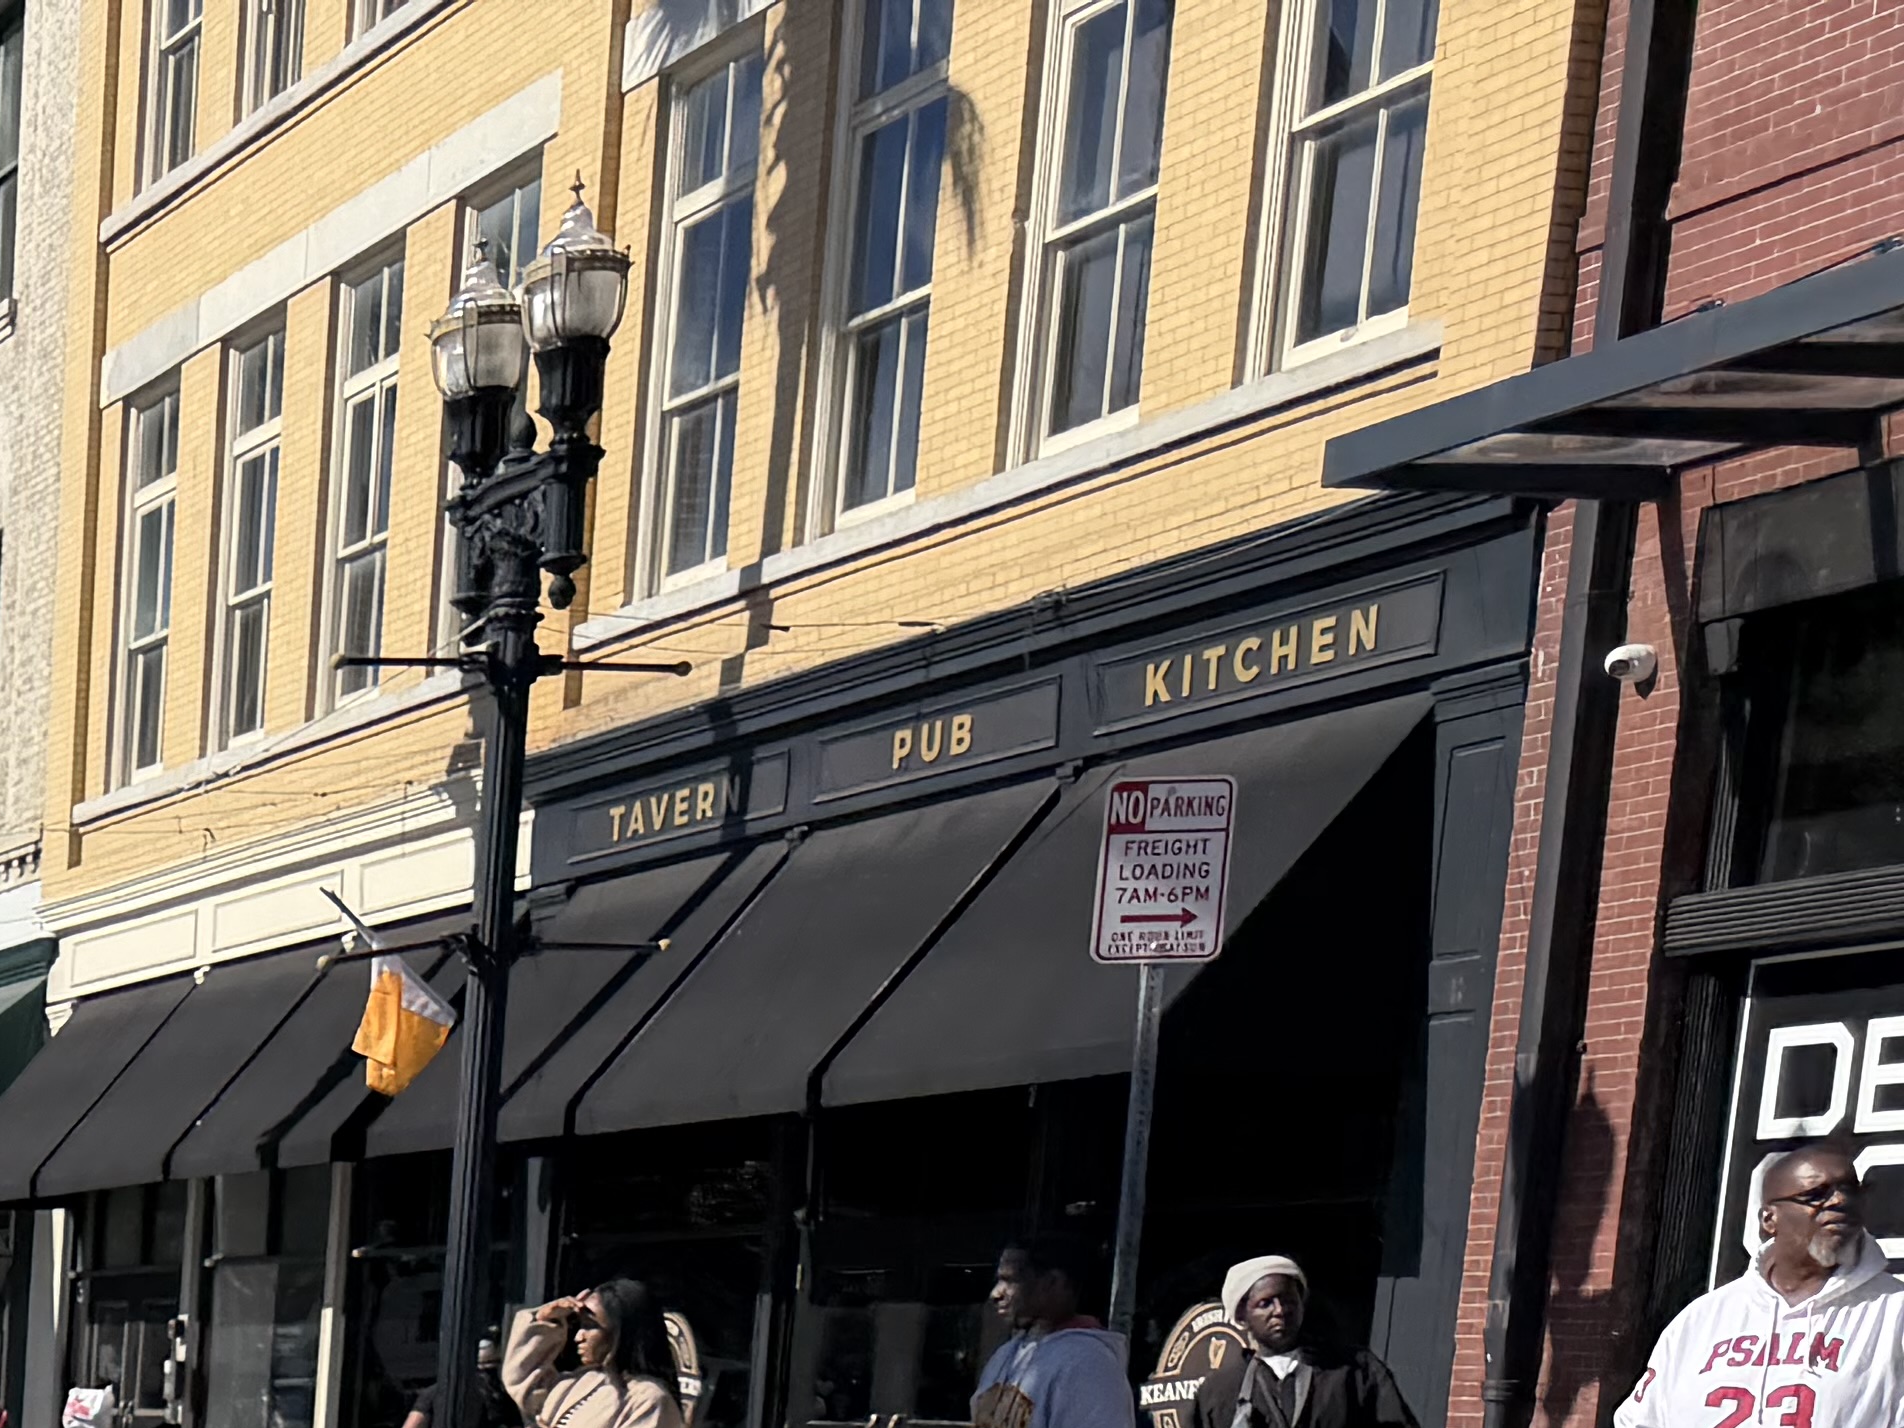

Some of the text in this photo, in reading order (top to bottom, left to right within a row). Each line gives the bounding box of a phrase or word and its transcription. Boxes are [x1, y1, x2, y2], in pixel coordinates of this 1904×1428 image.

[1144, 603, 1379, 708] KITCHEN
[892, 713, 973, 770] PUB
[608, 773, 741, 843] TAVERN
[1110, 790, 1228, 825] NO PARKING
[1123, 837, 1212, 857] FREIGHT
[1118, 861, 1211, 882] LOADING
[1698, 1330, 1845, 1376] PSALM
[1139, 1376, 1205, 1405] KEANE'
